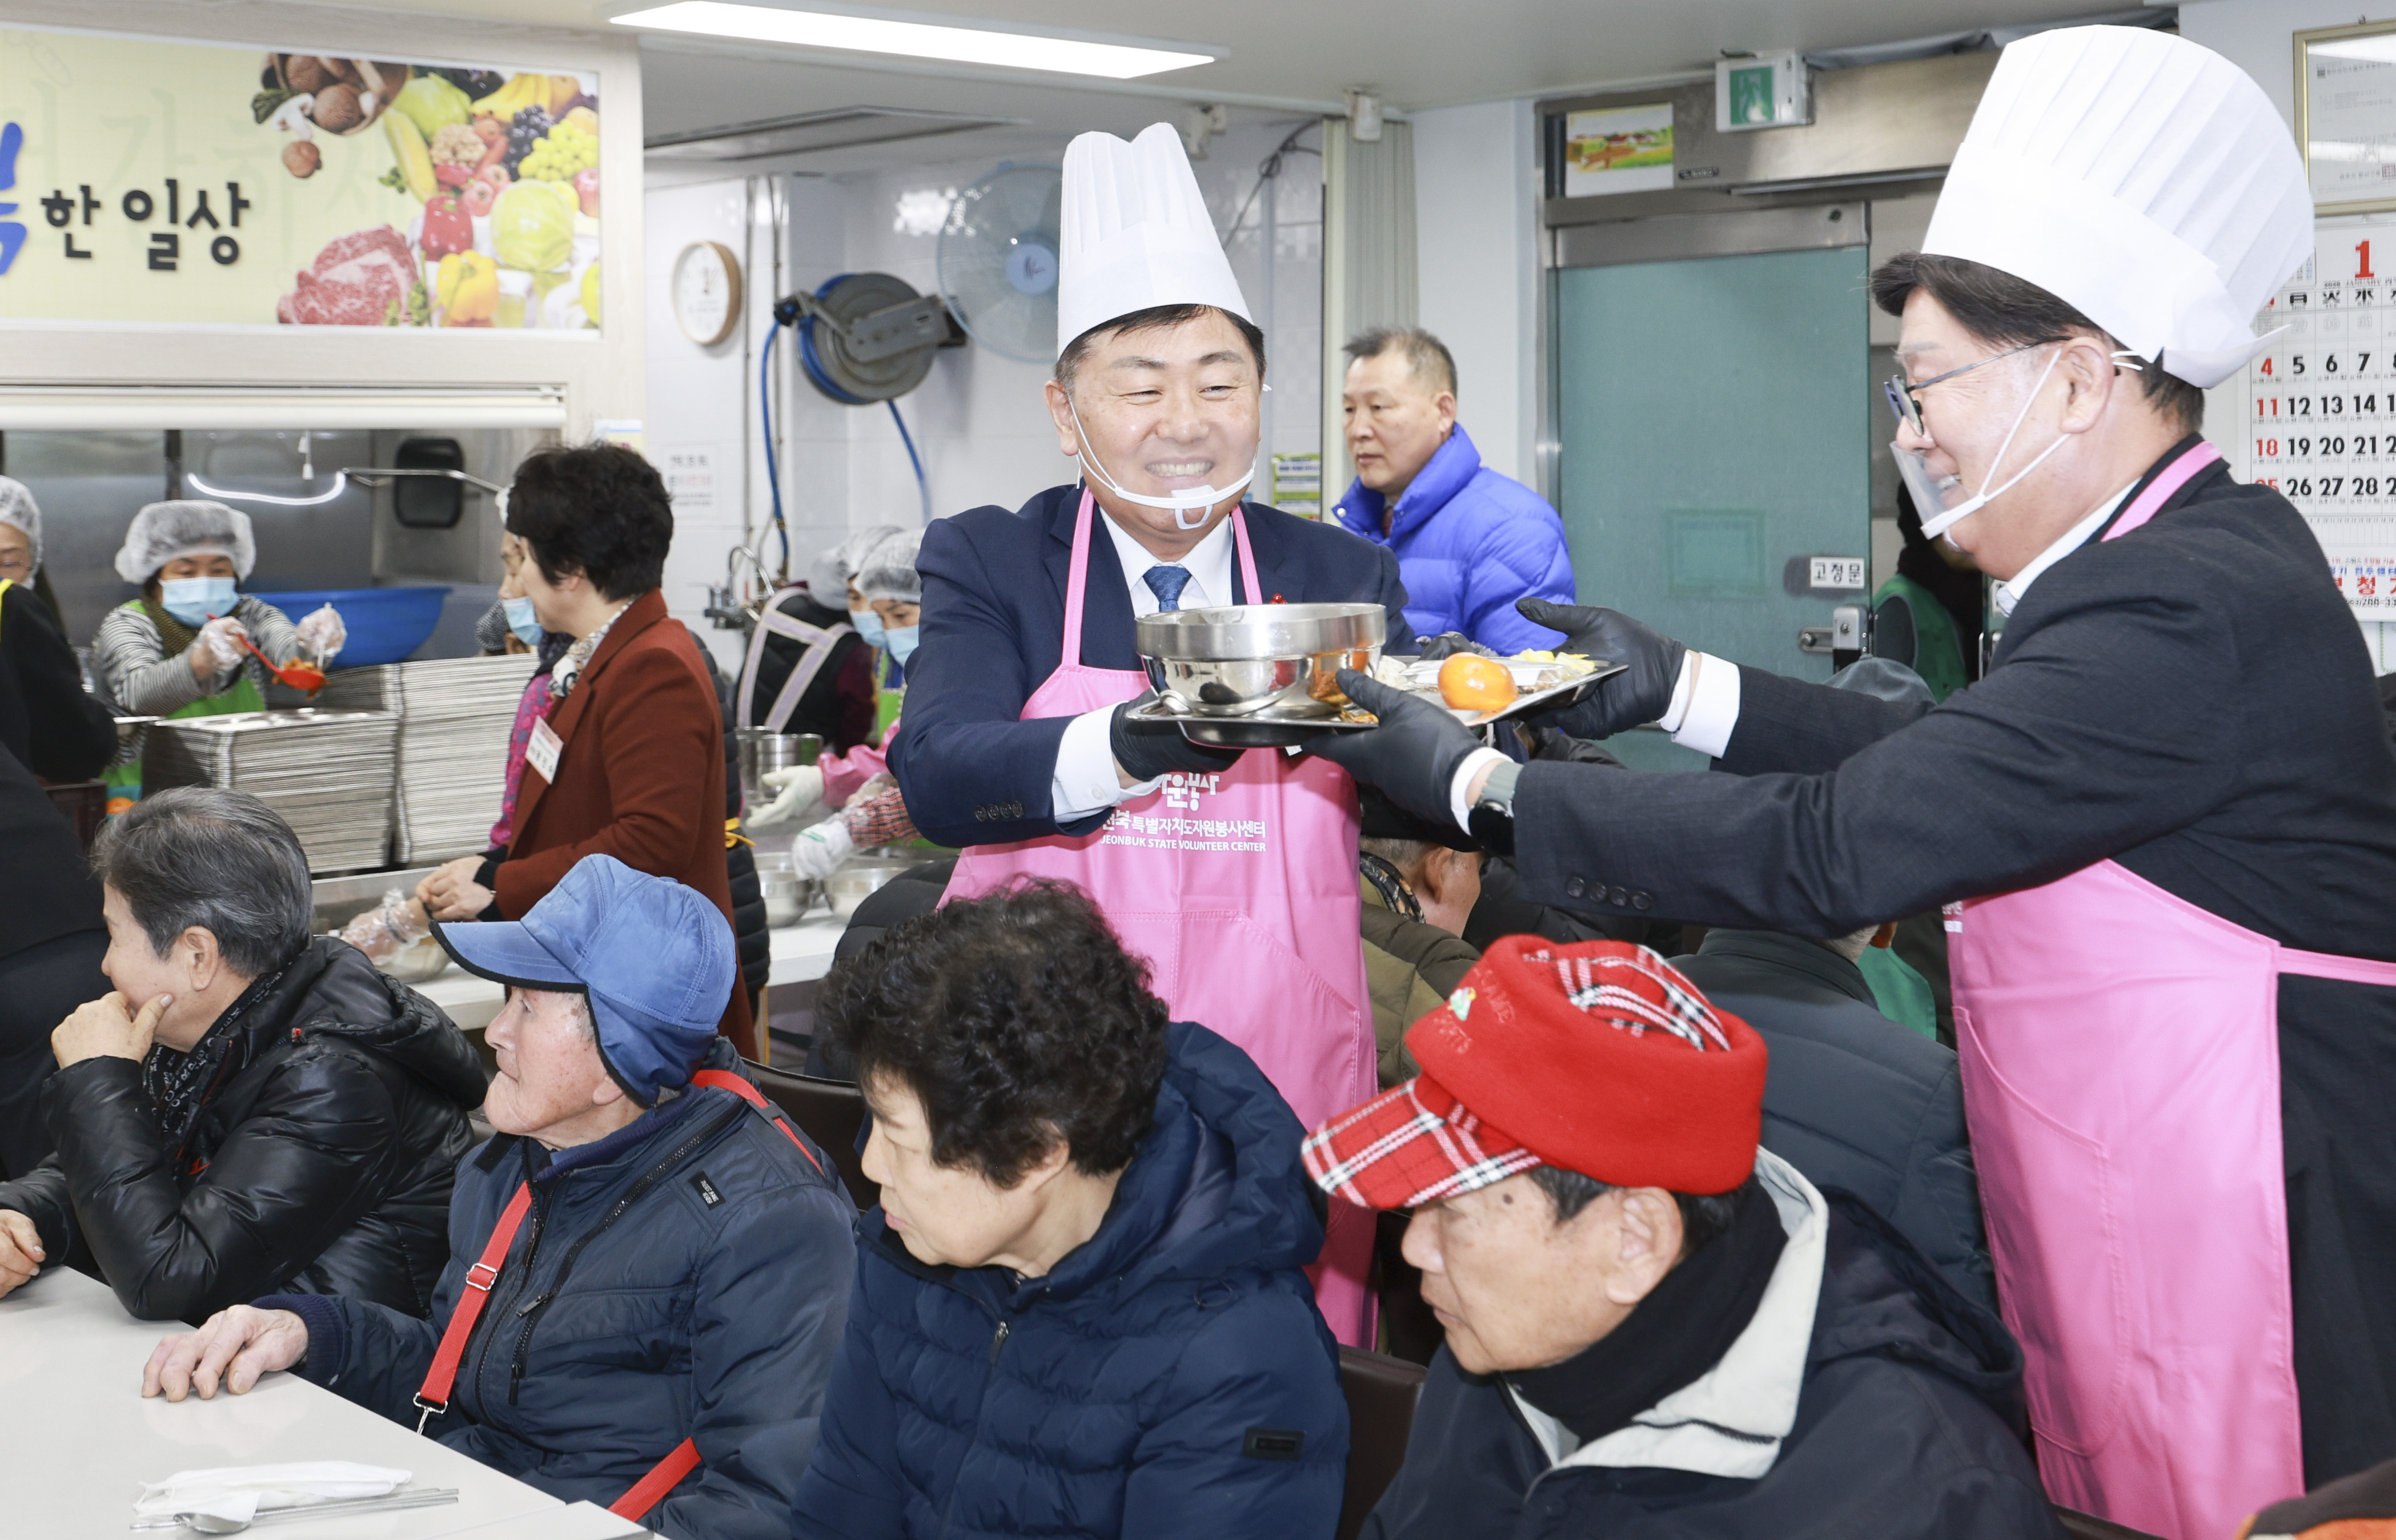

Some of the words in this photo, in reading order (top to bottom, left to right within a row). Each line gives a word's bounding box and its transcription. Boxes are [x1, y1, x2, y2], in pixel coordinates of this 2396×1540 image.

[122, 178, 250, 271] 일상
[2354, 239, 2375, 280] 1
[2354, 288, 2374, 305] 水
[2261, 357, 2273, 376] 4
[2293, 355, 2305, 374] 5
[2326, 353, 2338, 372] 6
[2358, 352, 2370, 371] 7
[2257, 398, 2278, 417] 11
[2288, 397, 2310, 415] 12
[2321, 396, 2343, 414] 13
[2354, 394, 2376, 413] 14
[2387, 394, 2396, 412] 1
[2256, 438, 2278, 457] 18
[2288, 437, 2310, 456] 19
[2319, 437, 2345, 455] 20
[2354, 436, 2376, 454] 21
[2386, 435, 2396, 453] 2
[2255, 479, 2279, 492] 5
[2287, 477, 2311, 496] 26
[2319, 477, 2343, 496] 27
[2352, 477, 2378, 496] 28
[2386, 477, 2396, 495] 2
[1813, 562, 1862, 583] 고정문
[1101, 835, 1146, 847] JEONBUK
[1147, 838, 1177, 849] STATE
[1178, 840, 1229, 851] VOLUNTEER
[1231, 842, 1266, 852] CENTER
